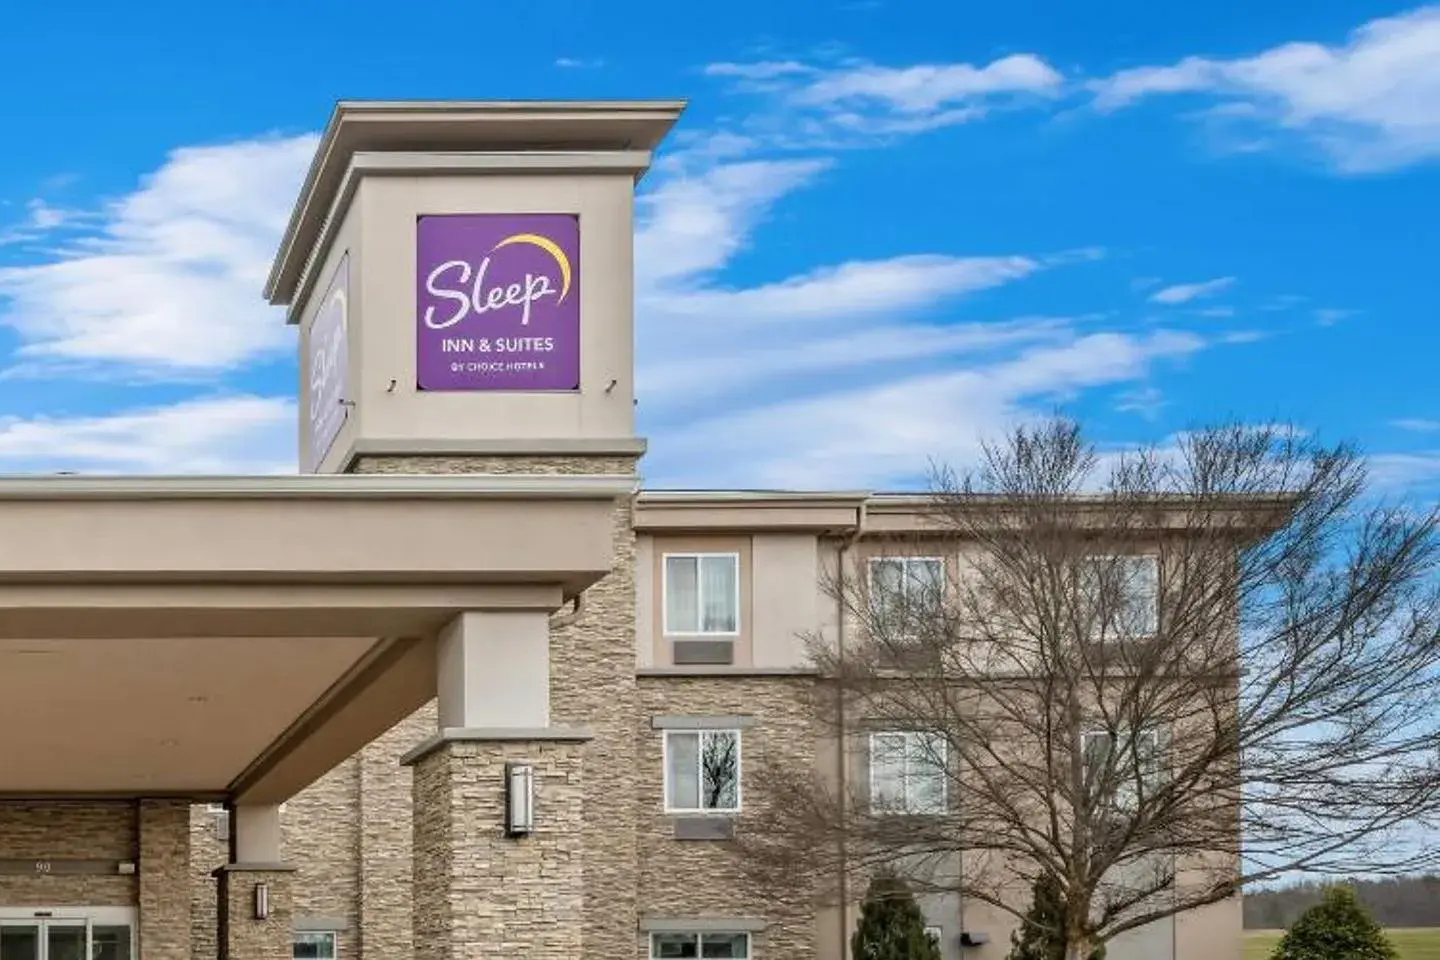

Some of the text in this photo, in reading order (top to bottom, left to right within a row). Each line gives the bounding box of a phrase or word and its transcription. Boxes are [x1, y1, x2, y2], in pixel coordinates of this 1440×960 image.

[424, 257, 556, 329] Sleep
[442, 337, 554, 352] INN & SUITES
